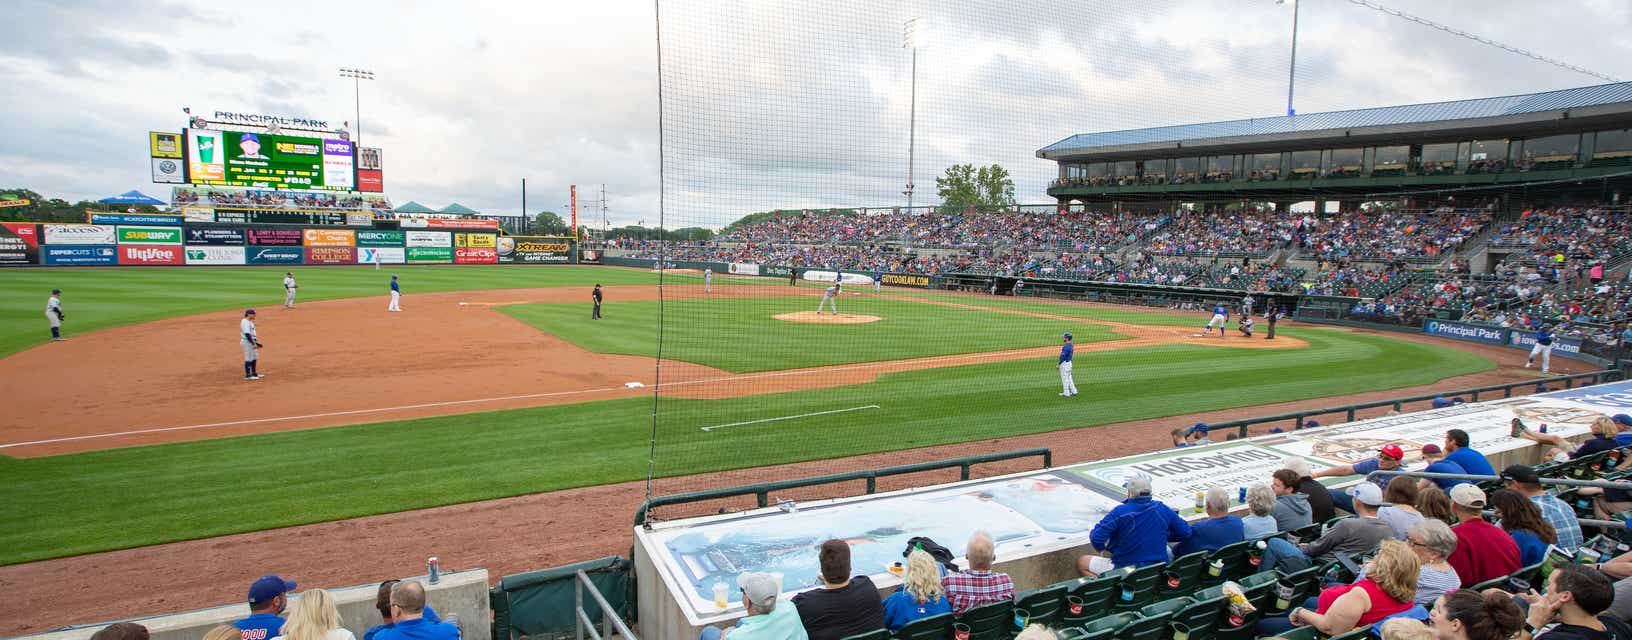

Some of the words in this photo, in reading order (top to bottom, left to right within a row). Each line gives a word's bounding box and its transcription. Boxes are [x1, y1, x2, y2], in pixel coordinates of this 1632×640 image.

[214, 111, 289, 125] PRINCIPAL
[292, 118, 328, 128] PARK
[125, 231, 175, 240] SUBWAY
[311, 247, 351, 255] SIMPSON
[517, 243, 568, 252] XTREAM
[311, 253, 352, 261] COLLEGE
[478, 250, 496, 258] Clips
[1439, 323, 1477, 337] Principal
[1479, 328, 1502, 340] Park
[1521, 334, 1580, 353] iowbs.com
[1131, 449, 1282, 477] HotSpring
[241, 628, 268, 640] OOD
